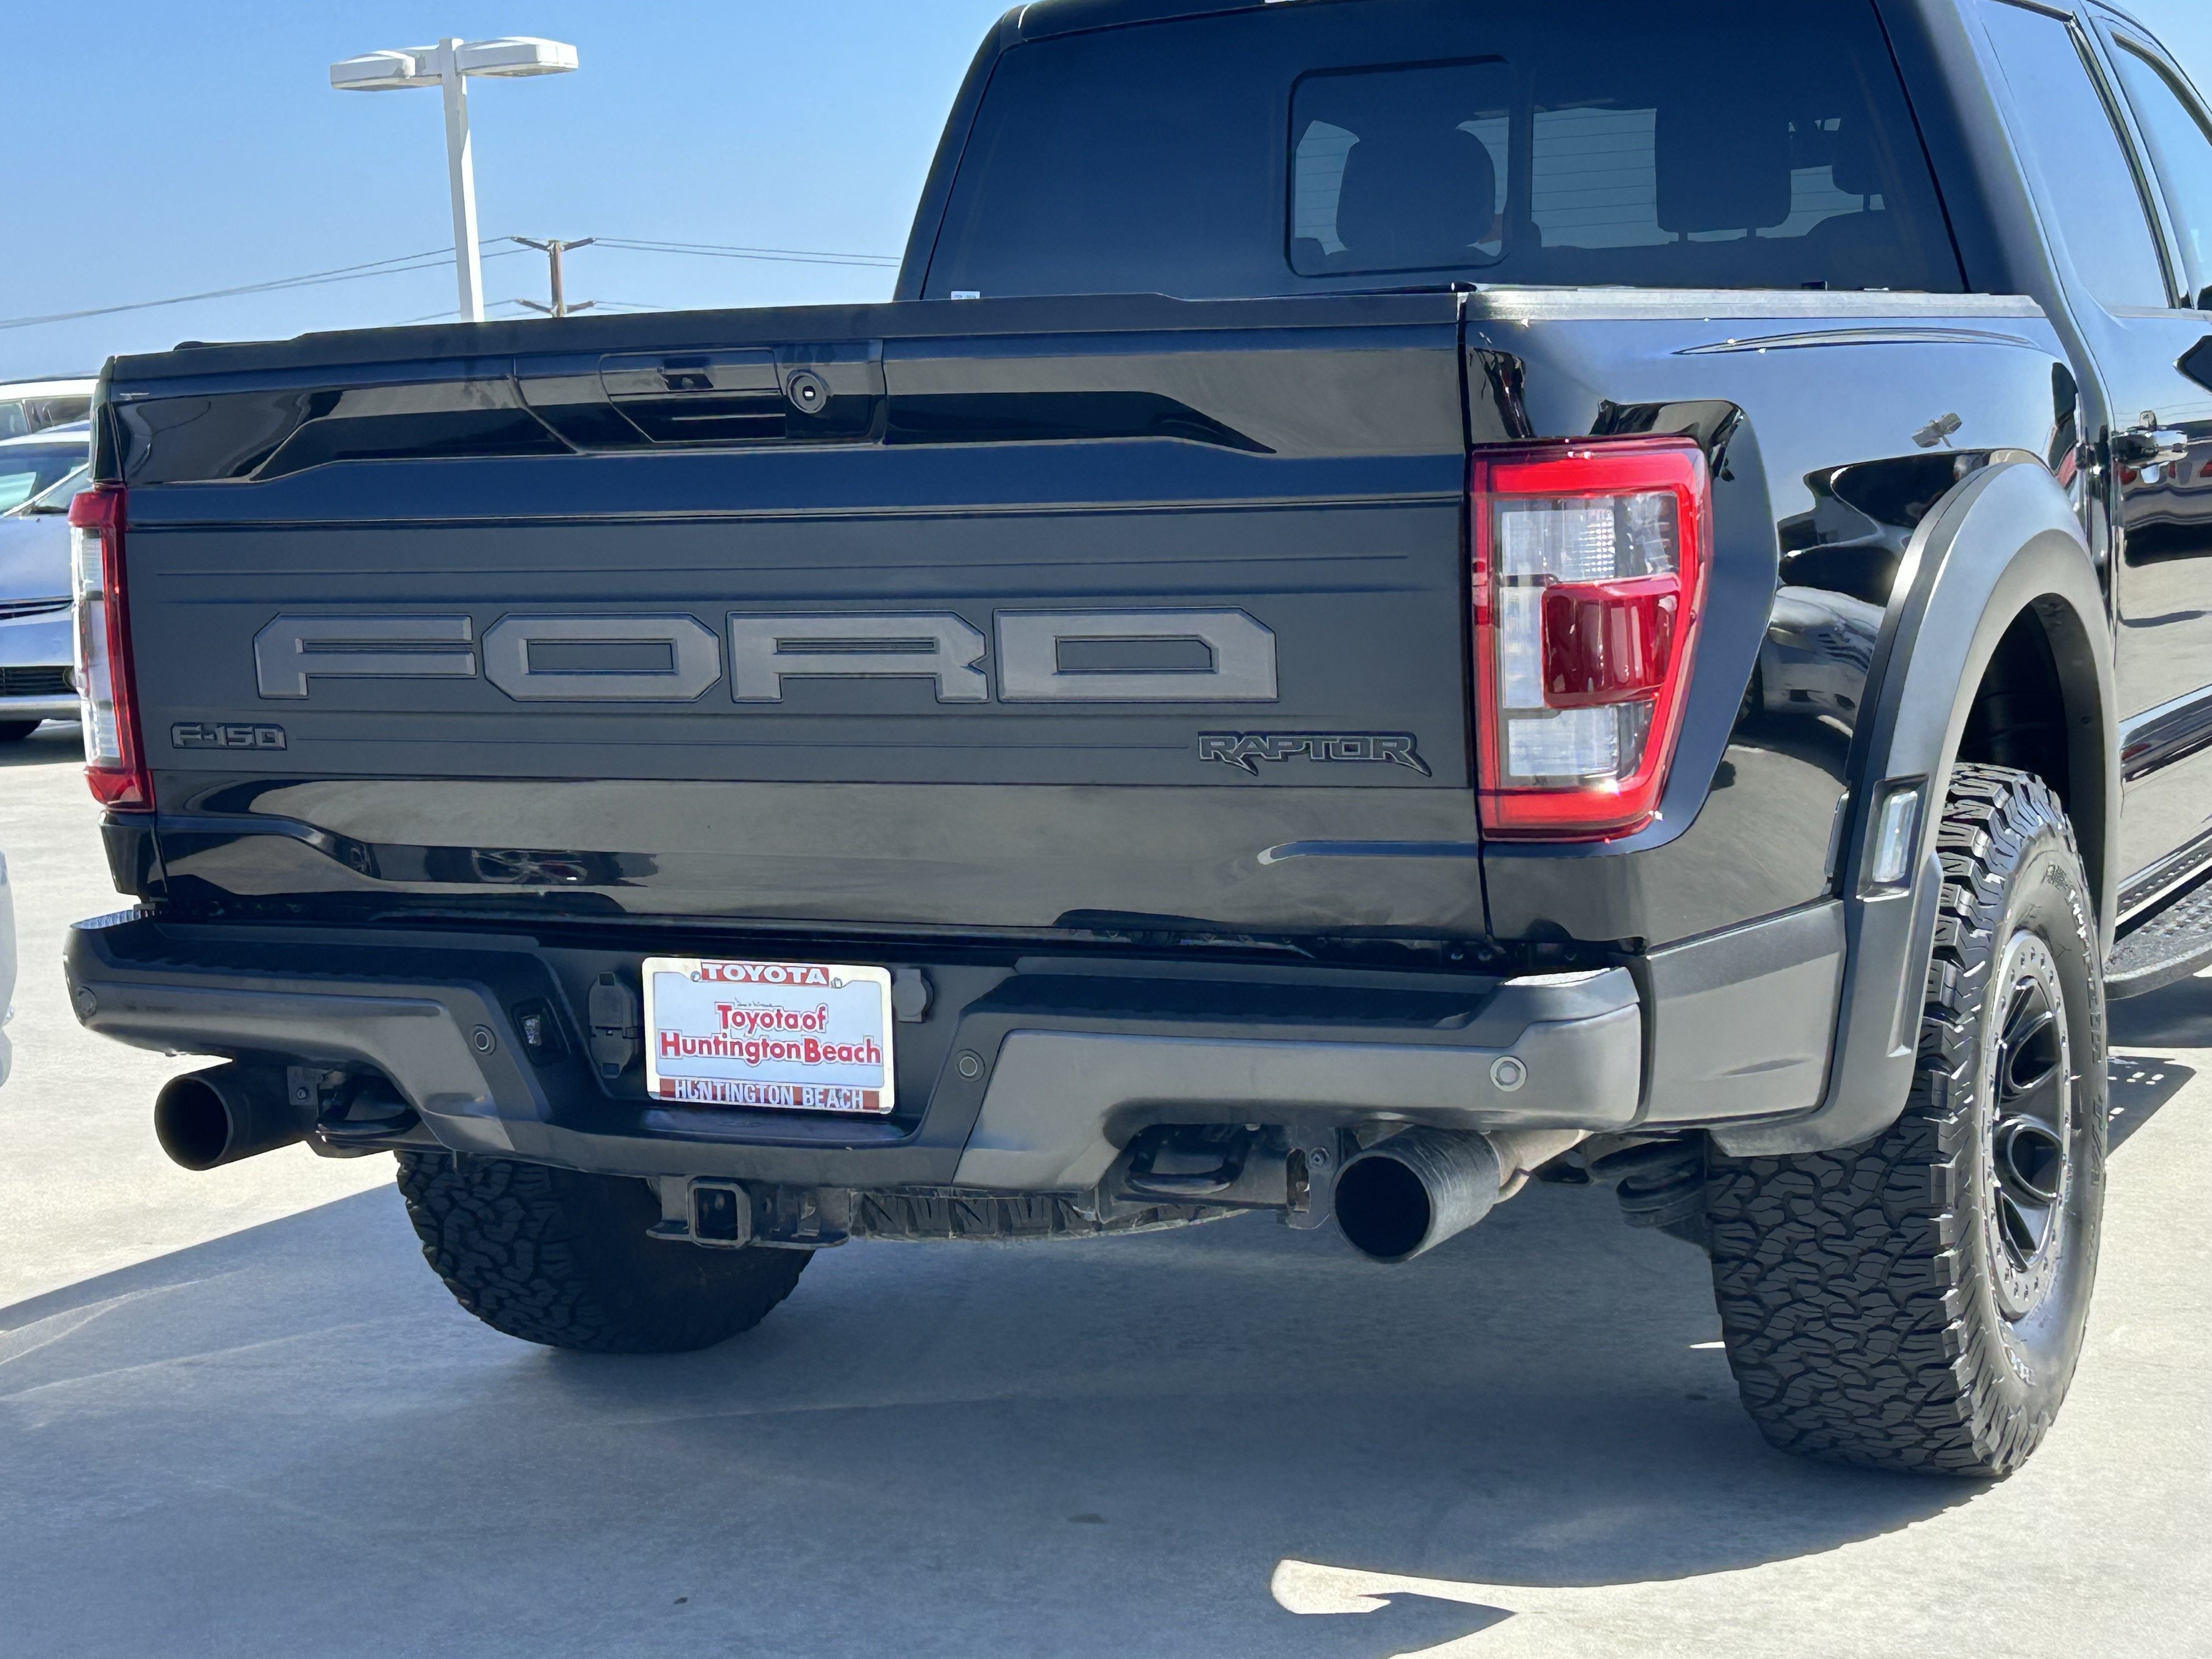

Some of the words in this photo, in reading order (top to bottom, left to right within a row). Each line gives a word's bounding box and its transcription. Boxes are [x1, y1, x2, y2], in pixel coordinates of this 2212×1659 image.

[253, 607, 1279, 703] FORD
[171, 722, 287, 751] F-150
[1198, 731, 1432, 777] RAPTOR
[702, 963, 827, 985] TOYOTA
[718, 1005, 799, 1034] Toyota
[802, 1006, 826, 1030] of
[661, 1032, 802, 1064] Huntington
[803, 1037, 882, 1064] Beach
[674, 1079, 794, 1106] HUNTINGTON
[802, 1086, 864, 1109] BEACH
